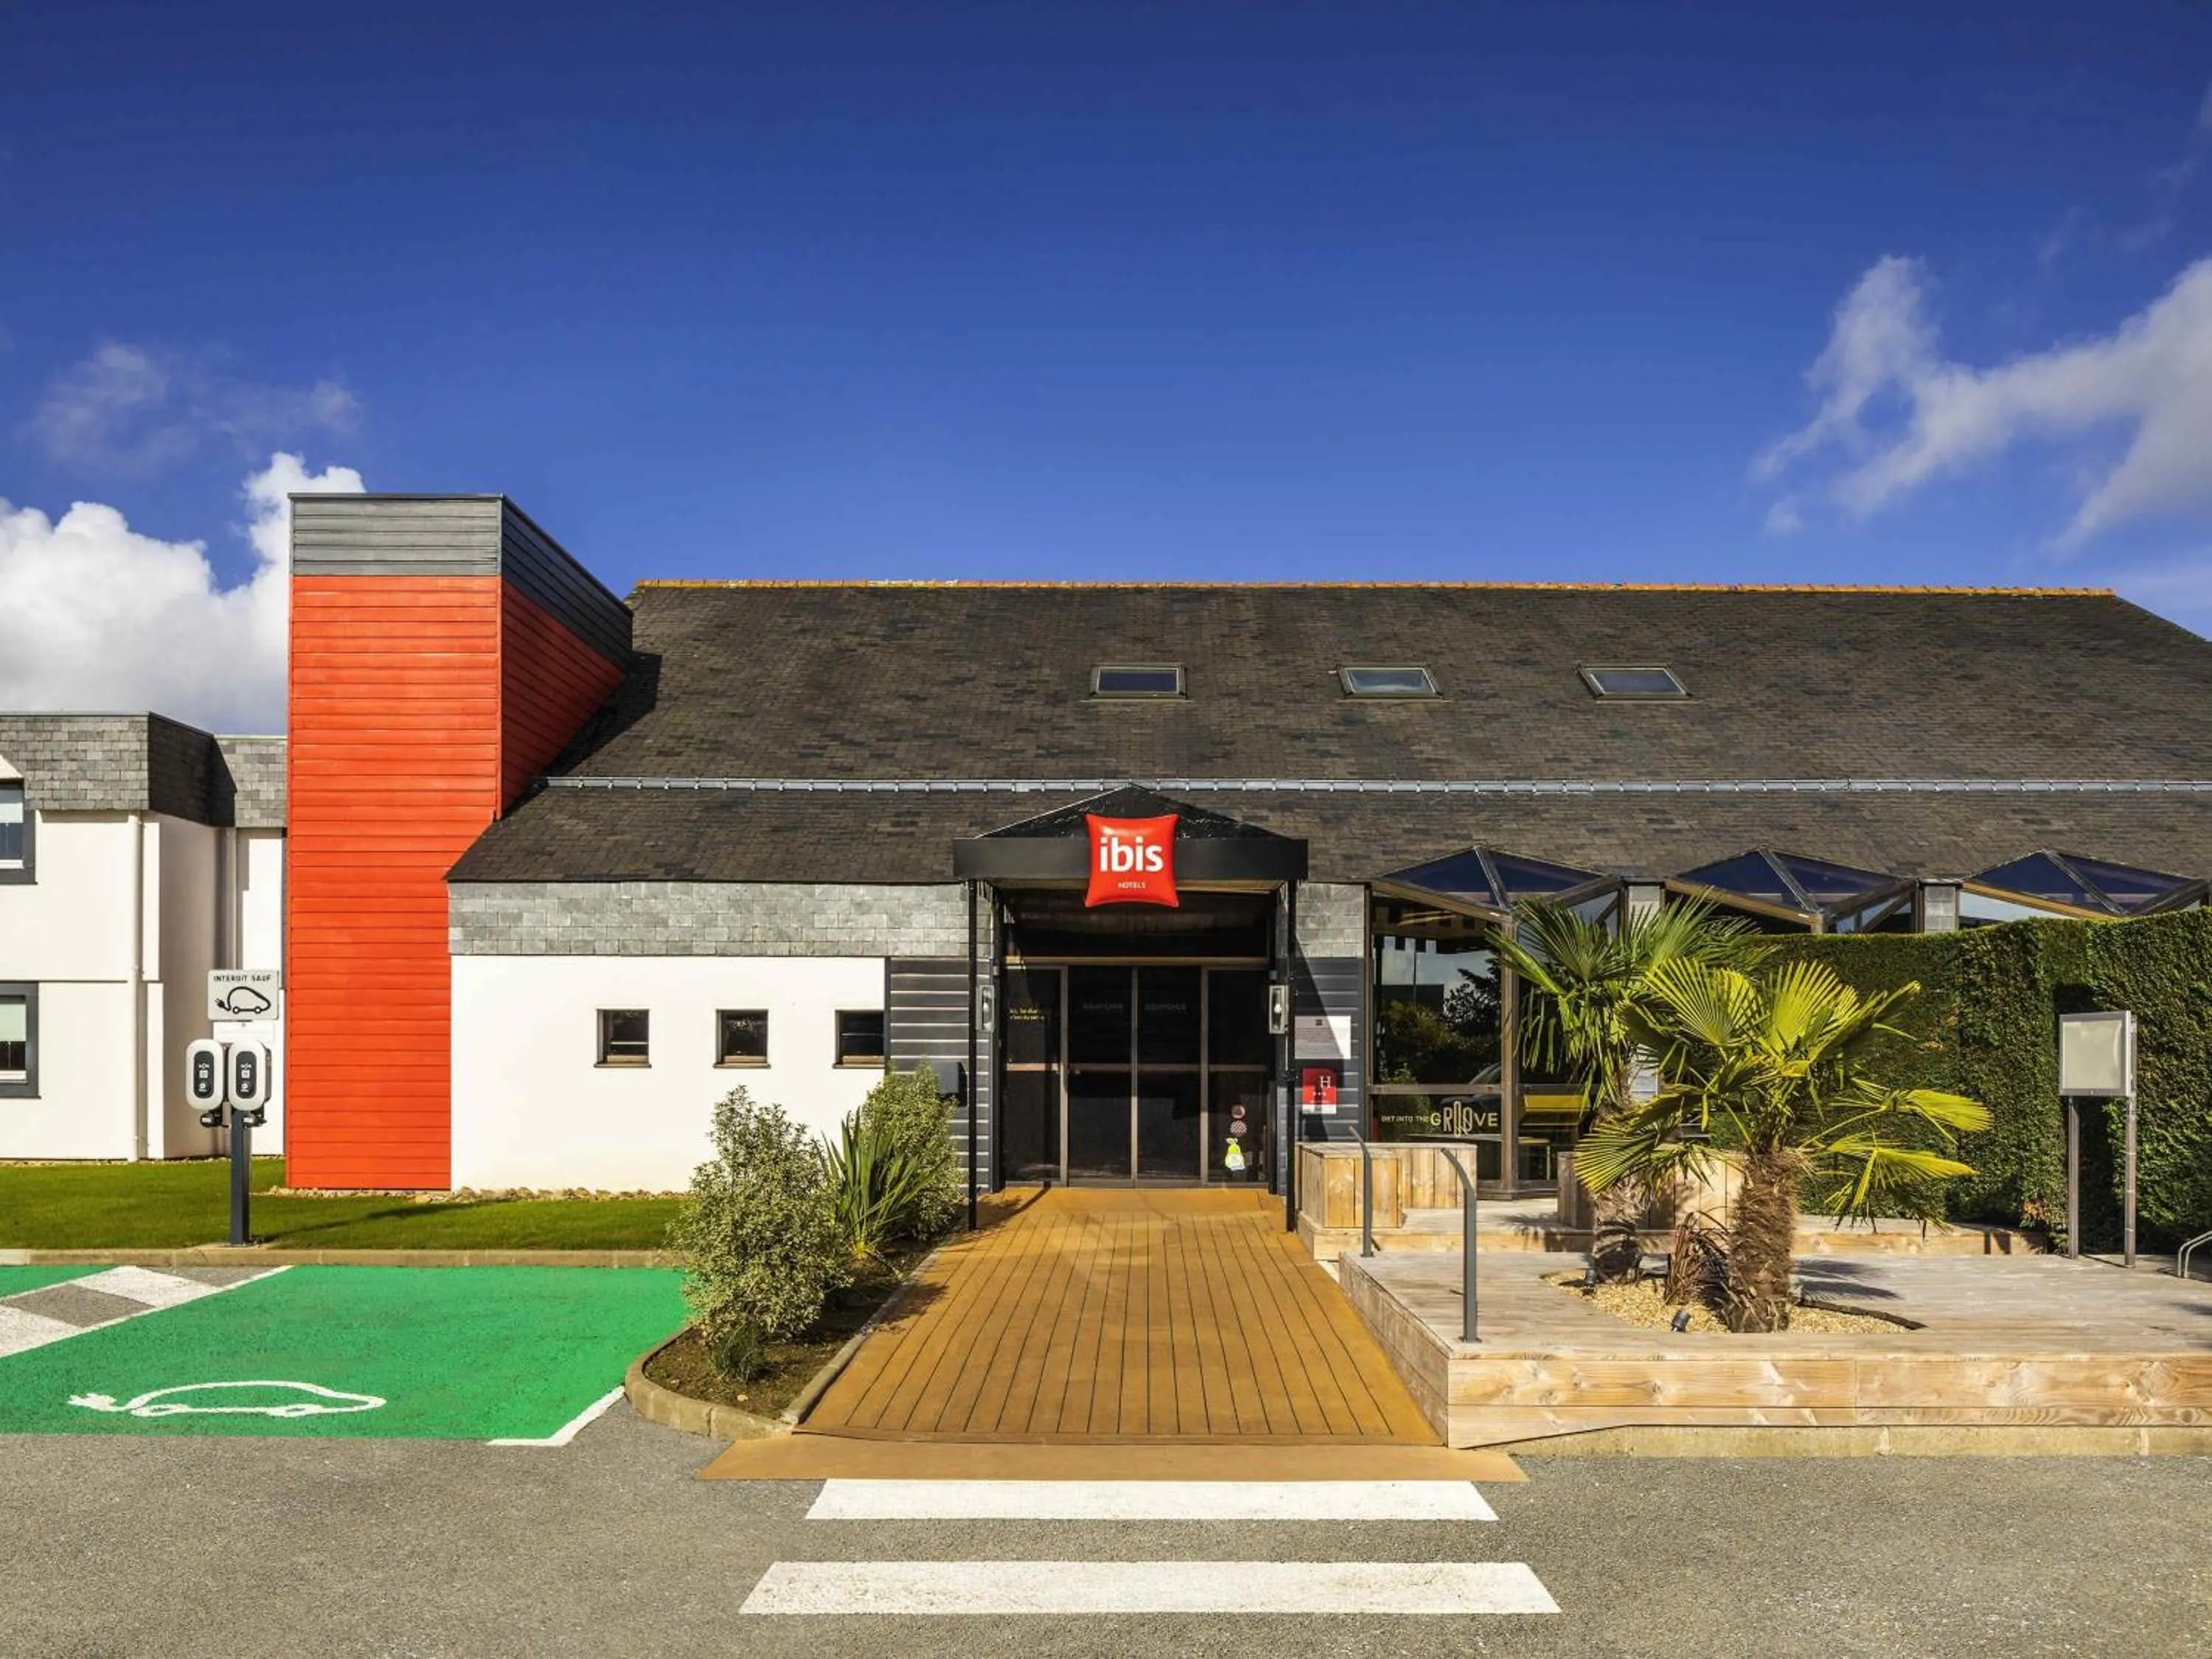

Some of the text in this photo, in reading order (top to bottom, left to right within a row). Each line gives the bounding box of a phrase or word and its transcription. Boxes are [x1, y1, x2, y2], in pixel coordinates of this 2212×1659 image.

[1099, 835, 1164, 872] ibis
[1320, 1076, 1331, 1088] H
[1430, 1100, 1499, 1138] GROOVE
